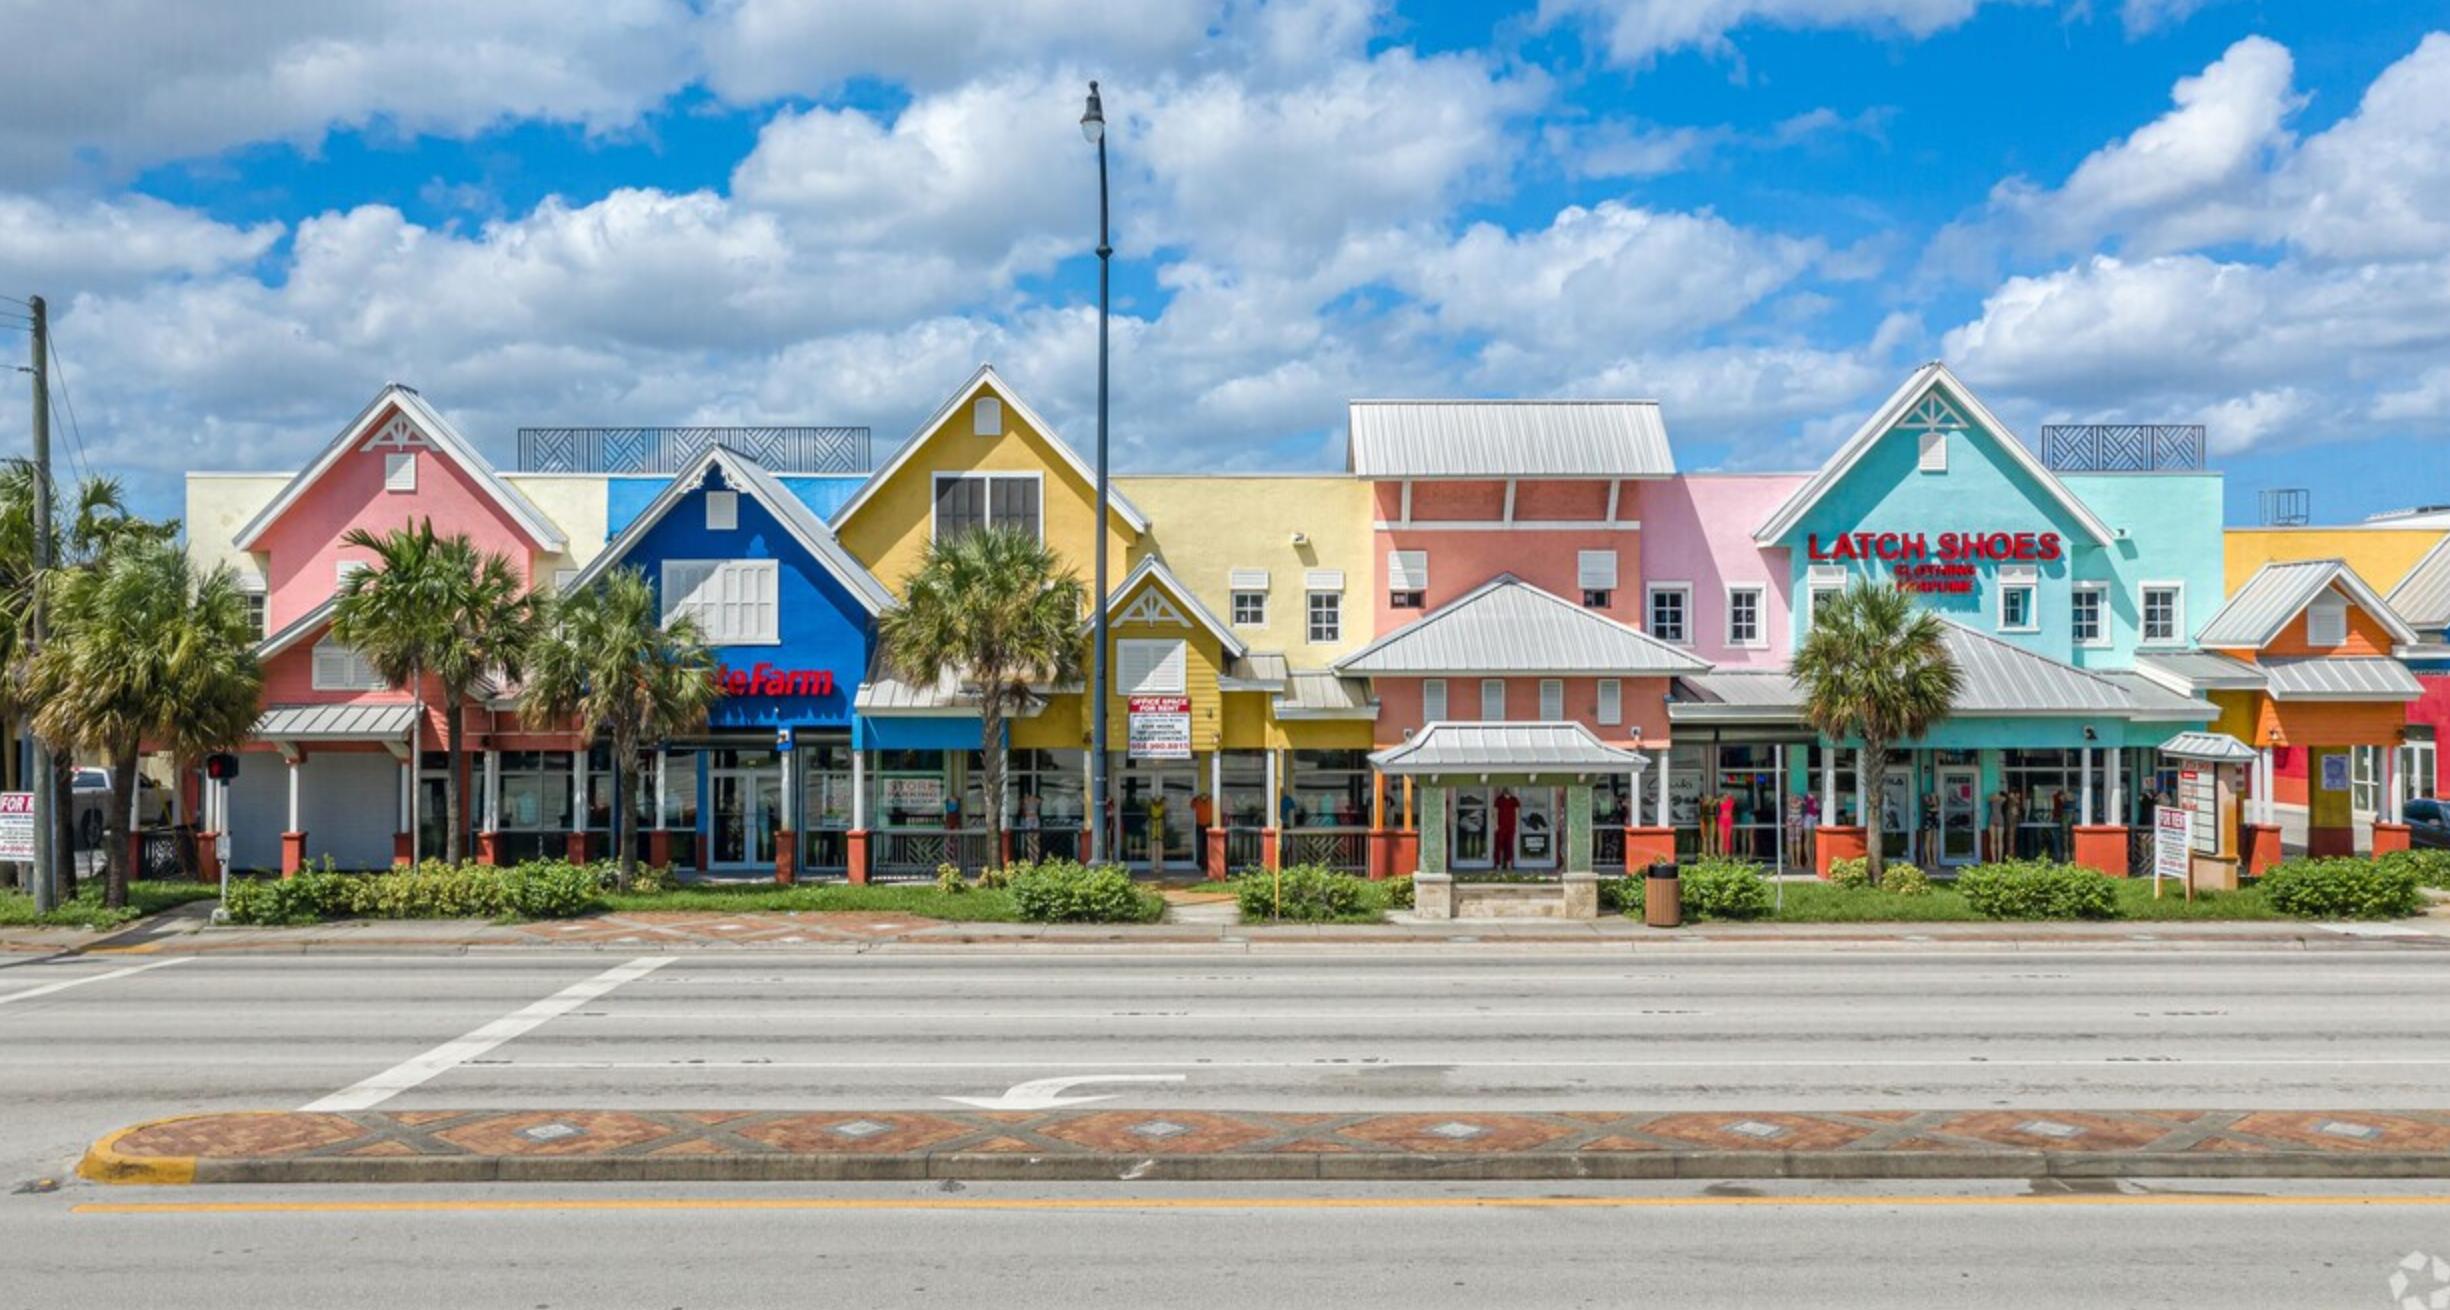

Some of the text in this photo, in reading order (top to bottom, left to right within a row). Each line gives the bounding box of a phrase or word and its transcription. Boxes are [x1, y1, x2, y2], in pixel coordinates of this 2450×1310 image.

[1808, 532, 2061, 561] LATCH SHOES
[1, 796, 24, 811] FOR
